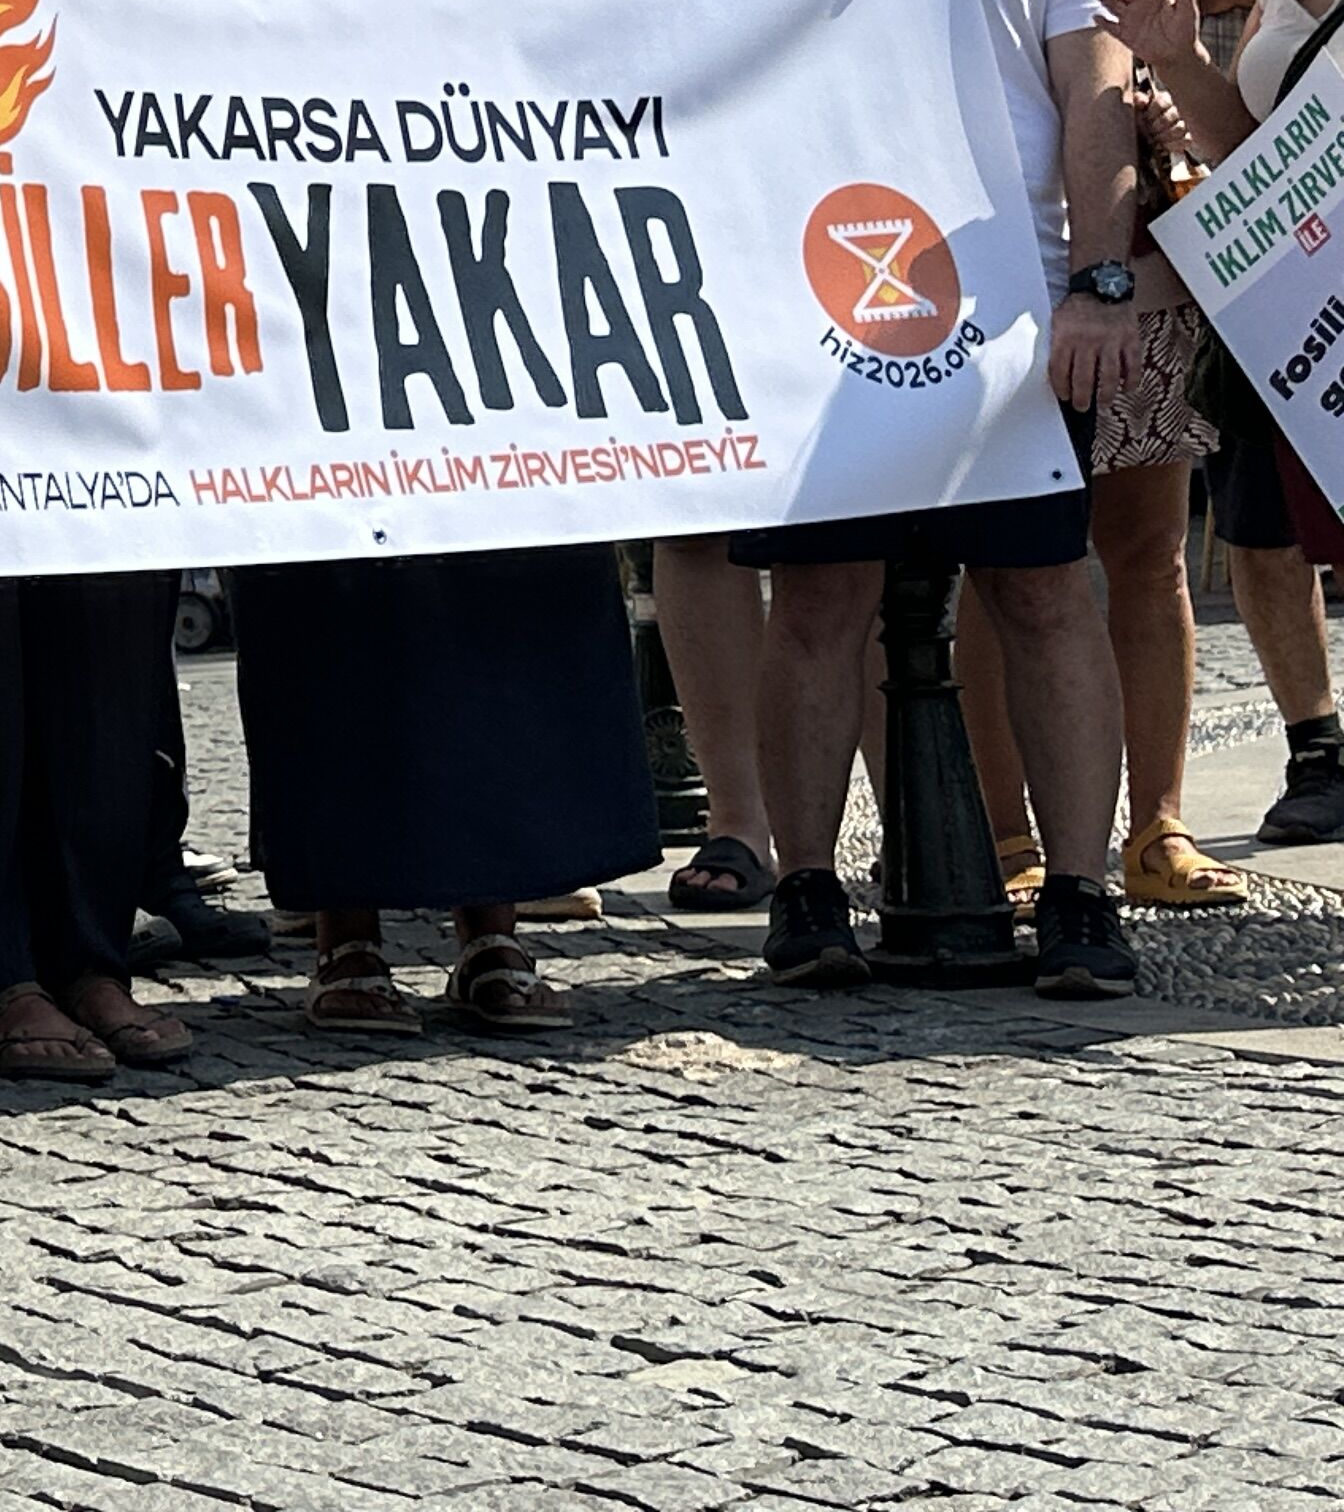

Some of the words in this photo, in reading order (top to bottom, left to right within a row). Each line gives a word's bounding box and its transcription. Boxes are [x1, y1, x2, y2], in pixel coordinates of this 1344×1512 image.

[94, 88, 390, 163] YAKARSA
[396, 82, 670, 163] DÜNYAYI
[1194, 93, 1331, 239] HALKLARIN
[1206, 206, 1288, 288] İKLİM
[1297, 217, 1330, 256] İLE
[246, 181, 750, 432] YAKAR
[819, 319, 986, 389] hiz2026.org
[189, 461, 391, 506] HALKLARIN
[391, 446, 490, 495] İKLİM
[495, 425, 767, 490] ZİRVESİ'NDEYİZ
